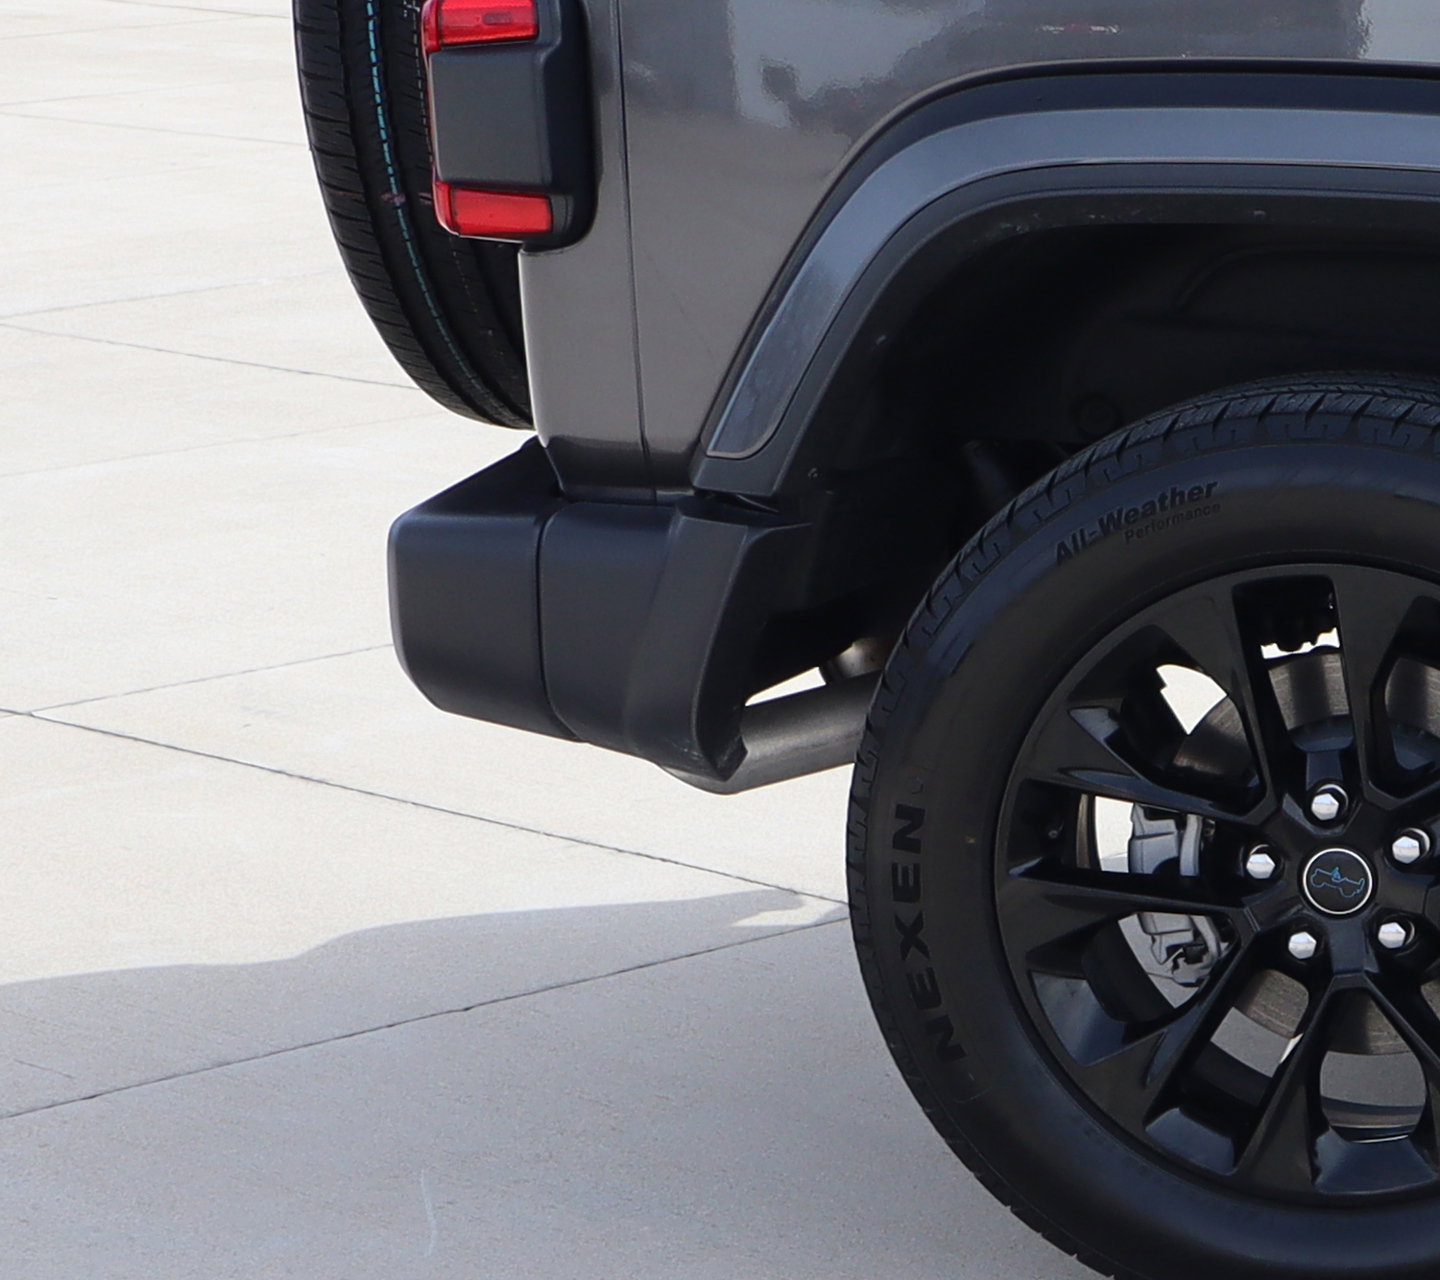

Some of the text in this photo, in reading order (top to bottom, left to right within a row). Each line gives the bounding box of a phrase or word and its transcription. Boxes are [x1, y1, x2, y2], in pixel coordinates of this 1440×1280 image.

[1055, 480, 1219, 567] All-Weather
[1124, 502, 1222, 545] Performance
[891, 802, 967, 1064] NEXEN
